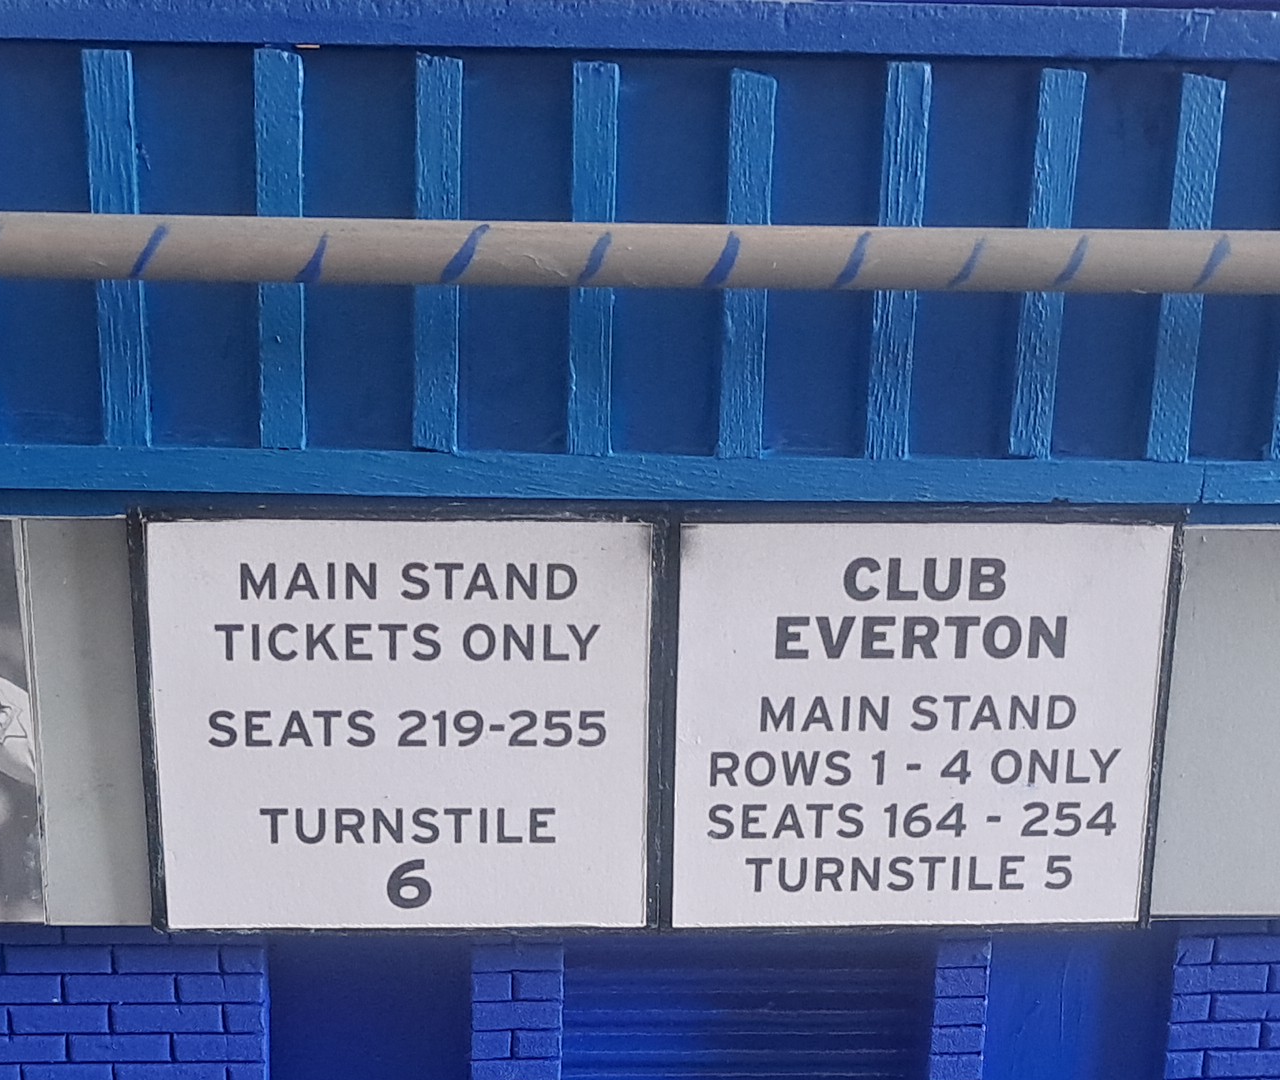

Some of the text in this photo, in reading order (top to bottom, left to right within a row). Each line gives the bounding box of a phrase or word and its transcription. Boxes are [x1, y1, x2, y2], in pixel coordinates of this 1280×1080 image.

[240, 562, 577, 600] MAIN STAND
[844, 557, 1005, 601] CLUB
[215, 623, 600, 661] TICKETS ONLY
[775, 616, 1067, 659] EVERTON
[209, 710, 606, 747] SEATS 219-255
[761, 695, 1076, 732] MAIN STAND
[710, 751, 851, 786] ROWS
[872, 751, 885, 785] 1
[941, 750, 971, 784] 4
[991, 749, 1121, 787] ONLY
[260, 808, 555, 844] TURNSTILE
[707, 803, 863, 839] SEATS
[884, 803, 966, 838] 164
[1021, 802, 1116, 836] 254
[387, 859, 431, 909] 6
[746, 856, 1072, 892] TURNSTILE 5
